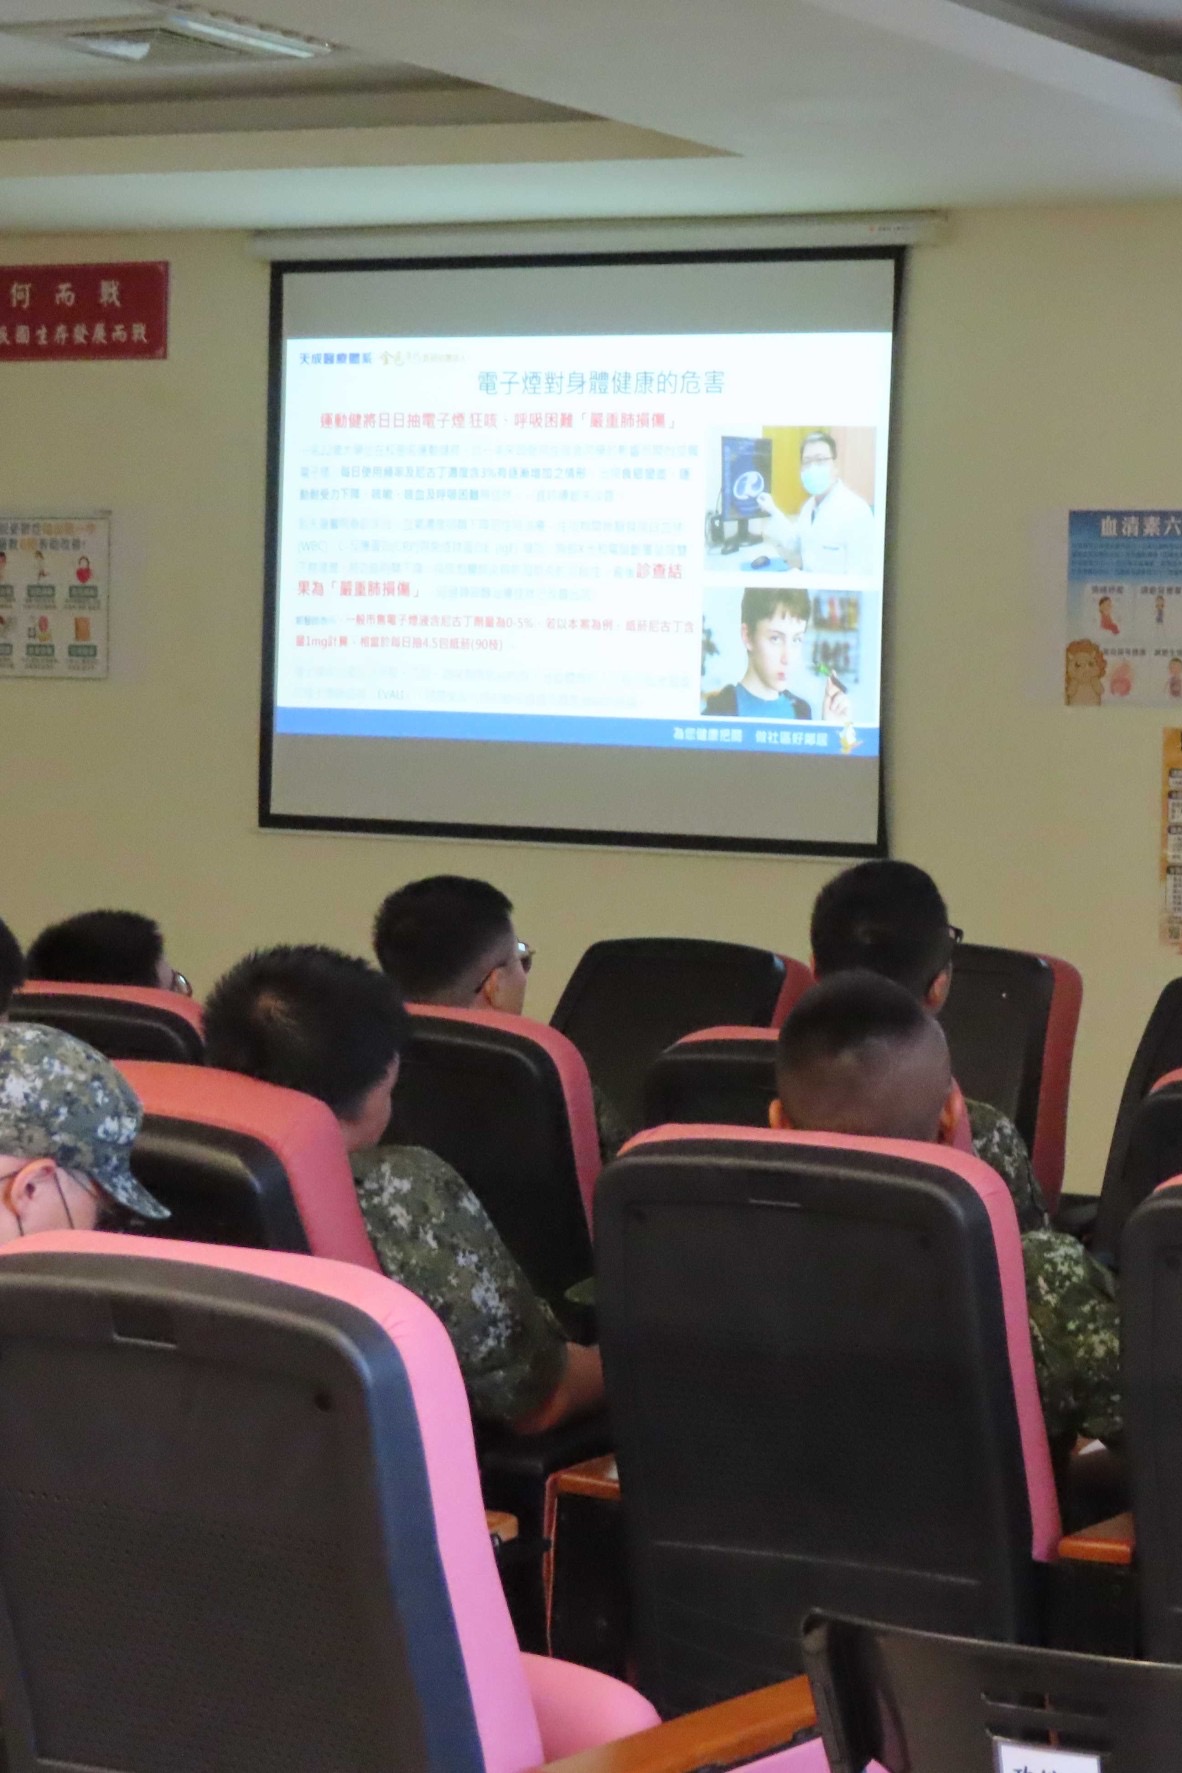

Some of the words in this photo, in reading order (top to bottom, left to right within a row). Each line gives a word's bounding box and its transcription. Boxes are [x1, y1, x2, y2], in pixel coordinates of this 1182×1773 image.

[478, 369, 726, 396] 電子煙對身體健康的危害
